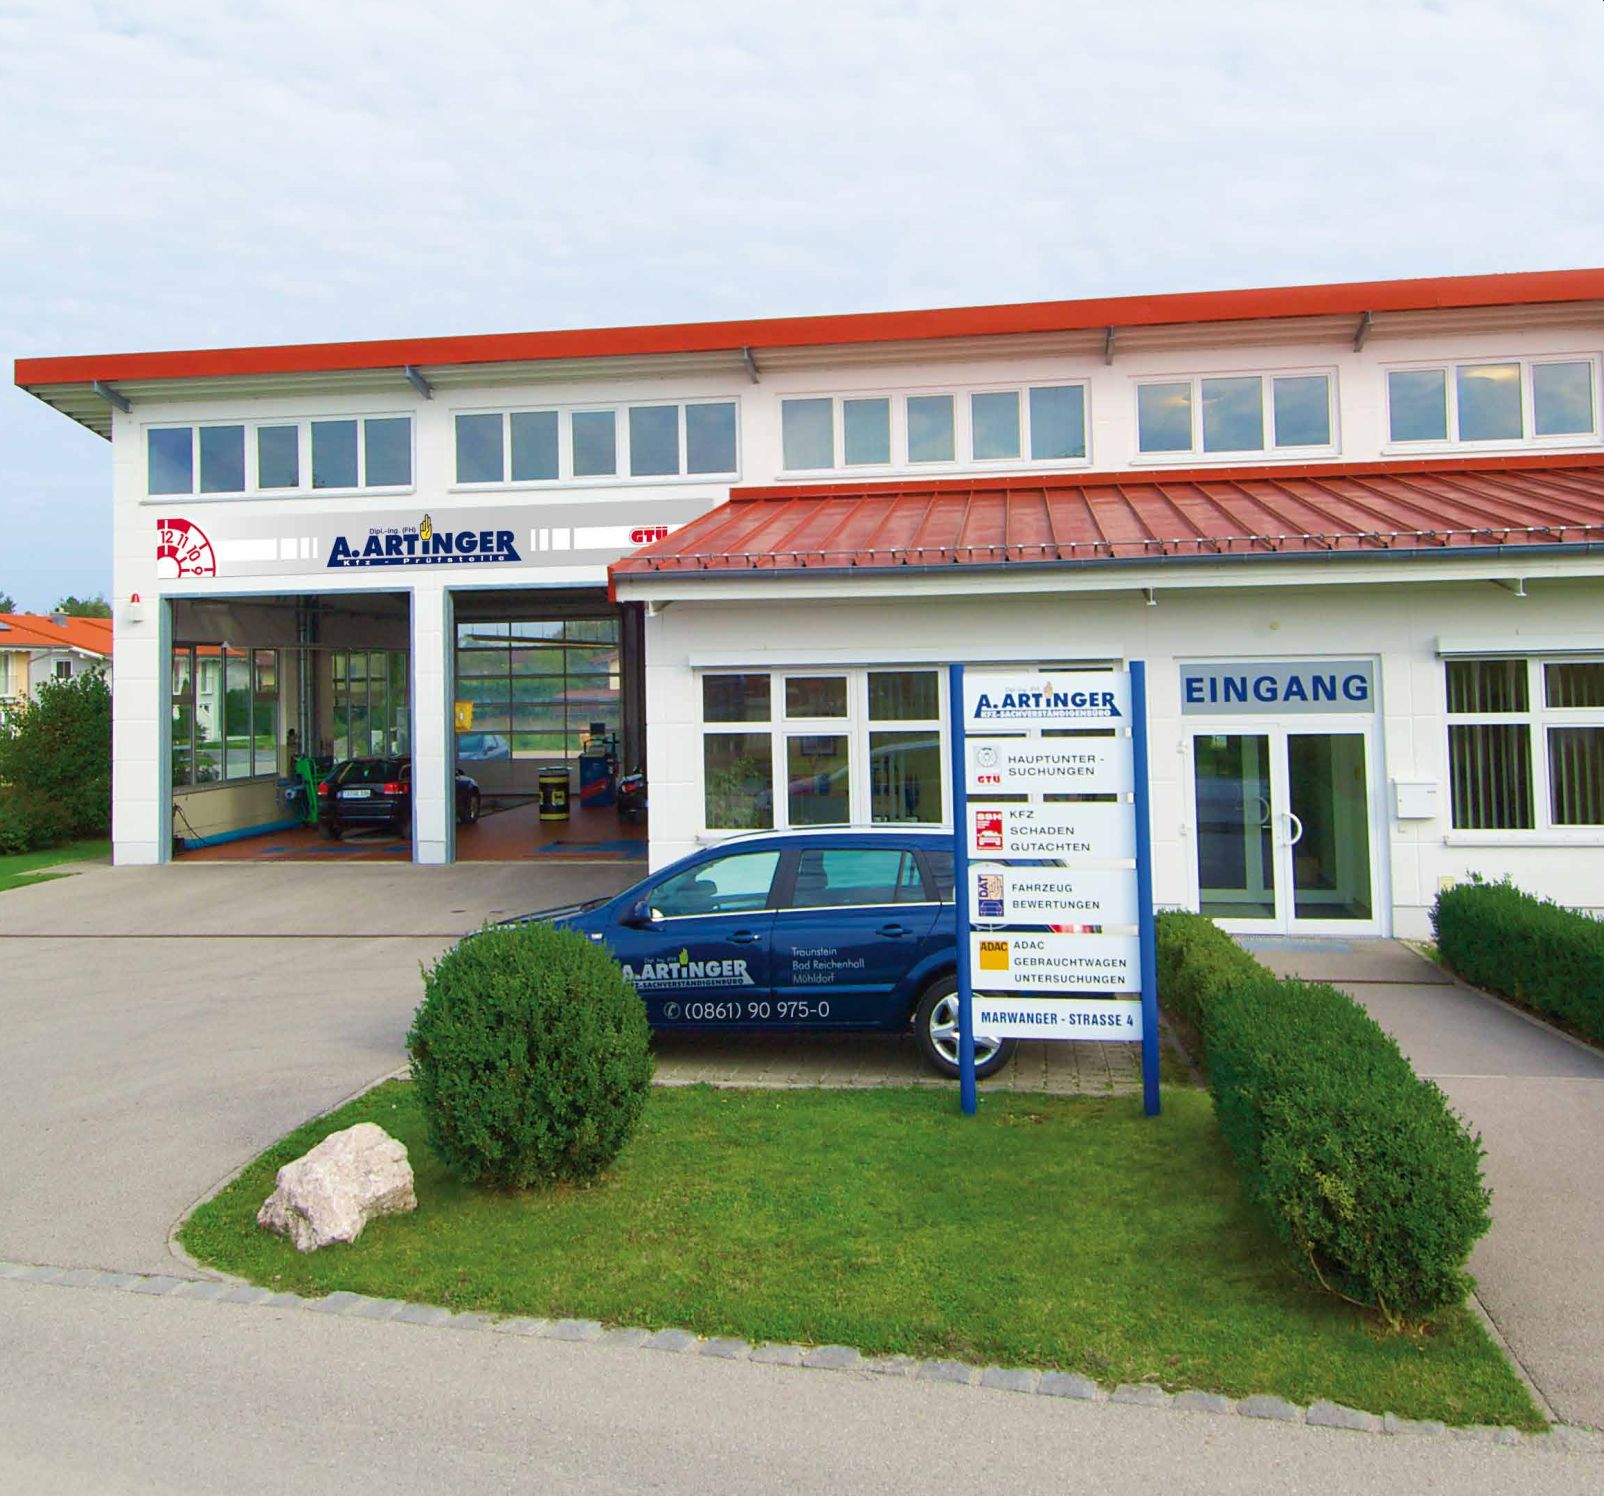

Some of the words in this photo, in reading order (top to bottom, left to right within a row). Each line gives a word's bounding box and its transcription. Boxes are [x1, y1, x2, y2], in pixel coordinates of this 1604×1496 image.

[161, 530, 174, 544] 12
[177, 533, 189, 549] 11
[186, 544, 201, 562] 10
[403, 555, 505, 565] Prüfstelle
[1185, 674, 1369, 703] EINGANG
[1008, 766, 1095, 776] SUCHUNGEN
[1010, 811, 1035, 819] KFZ
[1010, 826, 1075, 835] SCHADEN
[1010, 842, 1091, 852] GUTACHTEN
[979, 875, 989, 898] DAT
[1012, 883, 1073, 893] FAHRZEUG
[1012, 900, 1100, 910] BEWERTUNGEN
[980, 942, 1008, 951] ADAC
[1013, 941, 1045, 950] ADAC
[791, 946, 837, 957] Traunstein
[792, 960, 811, 970] Bad
[813, 958, 865, 970] Reichenhall
[1014, 957, 1127, 968] GEBRAUCHTWAGEN
[793, 972, 835, 984] Mühldorf
[1014, 974, 1125, 984] UNTERSUCHUNGEN
[685, 1002, 742, 1020] (0861)
[748, 1001, 771, 1019] 90
[777, 1001, 830, 1019] 975-0
[981, 1011, 1058, 1025] MARWANGER
[1069, 1013, 1122, 1026] STRASSE
[1126, 1015, 1134, 1027] 4
